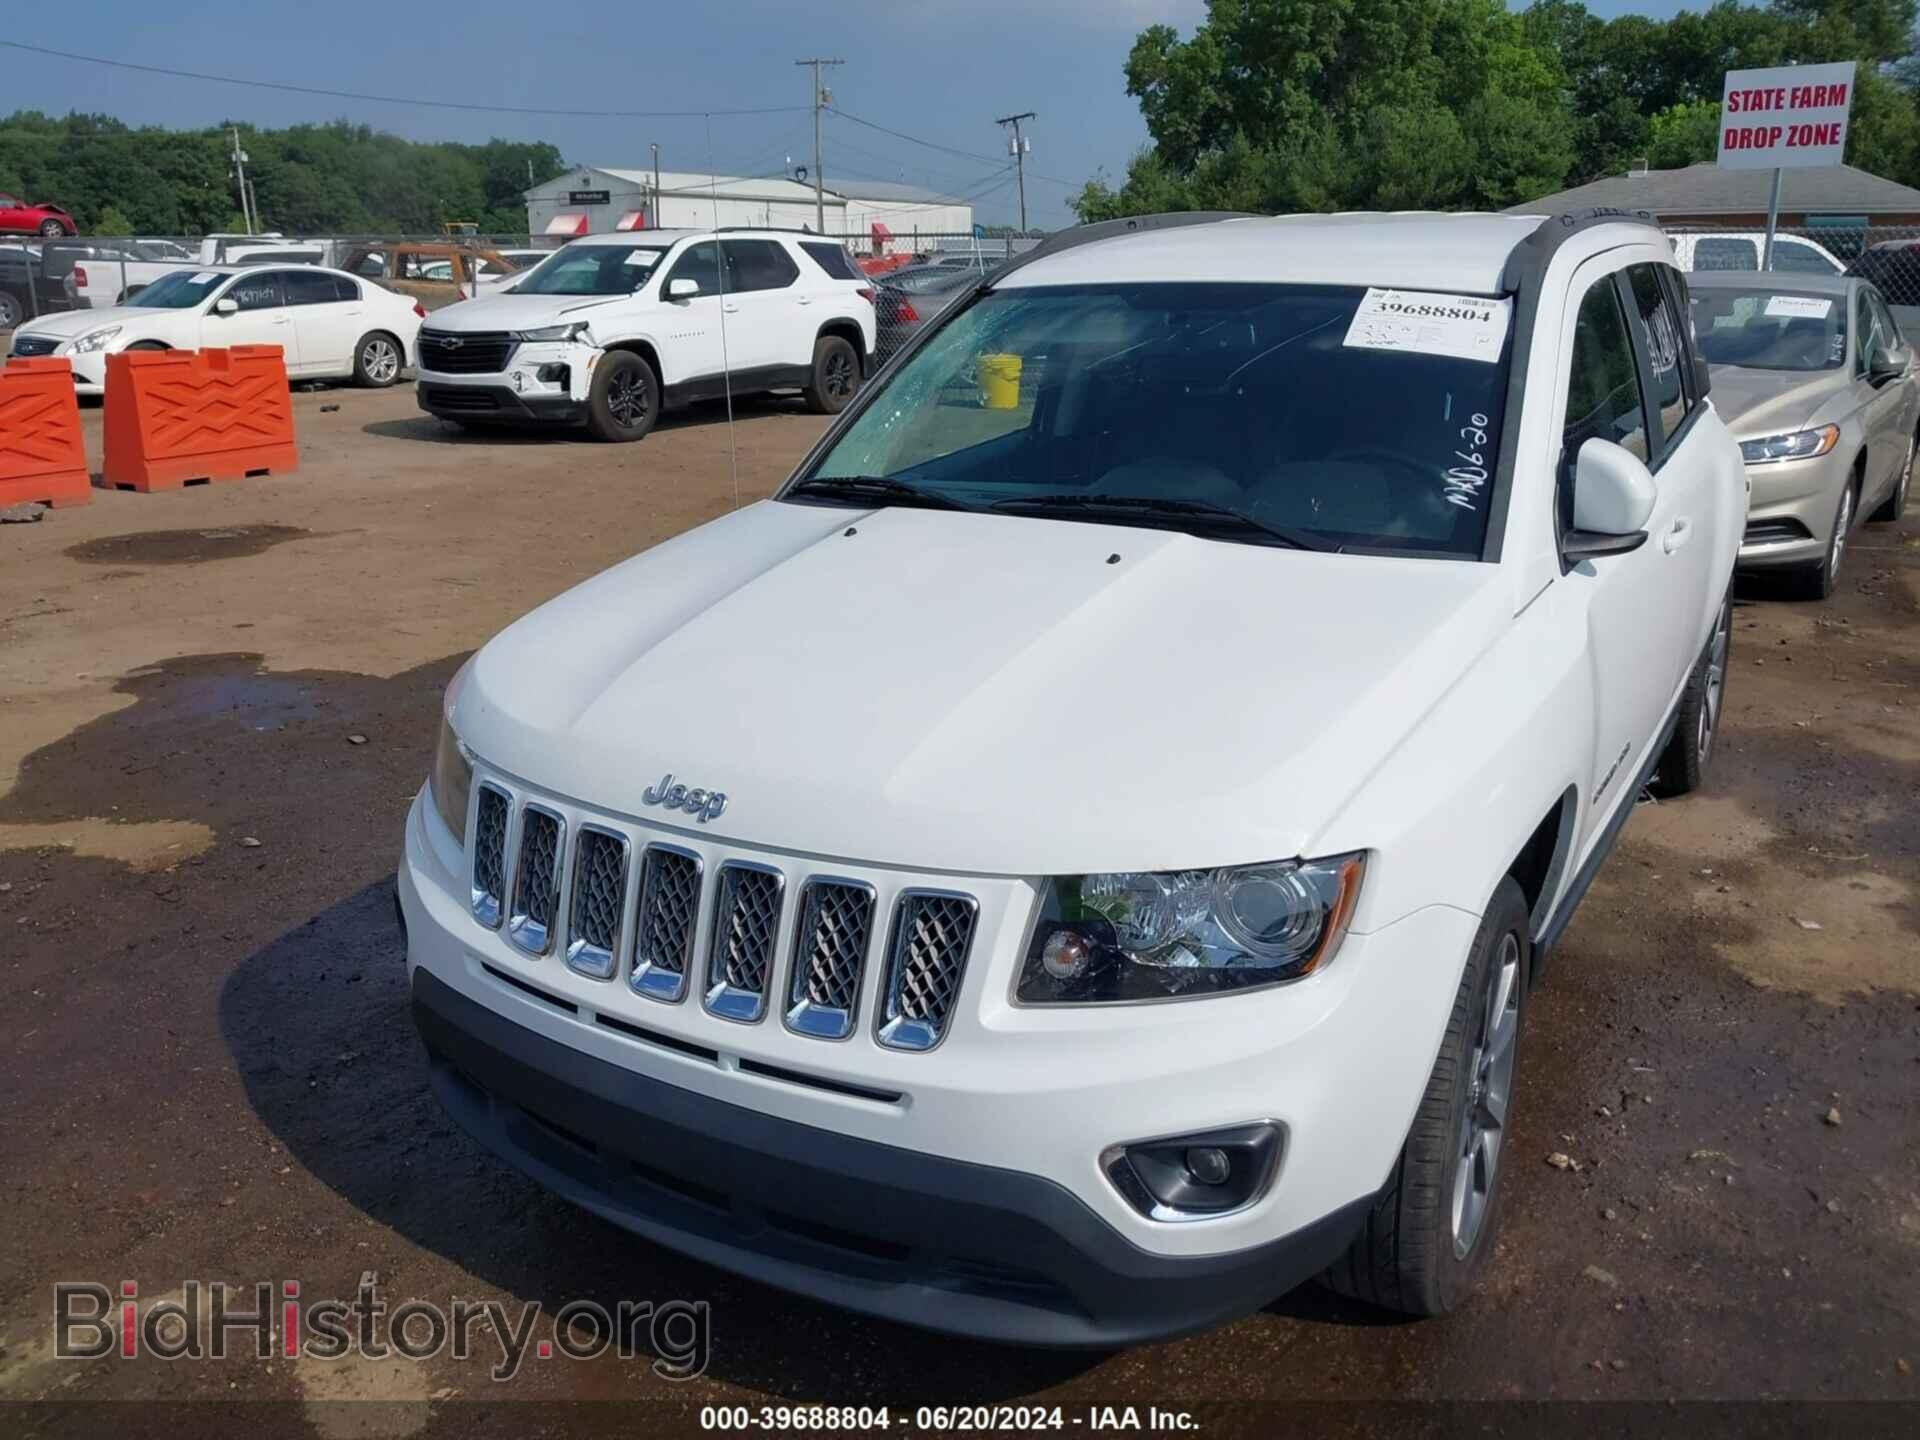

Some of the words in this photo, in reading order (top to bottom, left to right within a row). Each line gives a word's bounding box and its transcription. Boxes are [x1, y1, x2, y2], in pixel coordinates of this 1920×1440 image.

[1728, 88, 1785, 112] STATE
[1790, 84, 1847, 109] FARM
[1724, 127, 1782, 149] DROP
[1786, 123, 1841, 147] ZONE
[1373, 301, 1490, 322] 39688804
[642, 774, 728, 823] Jeep
